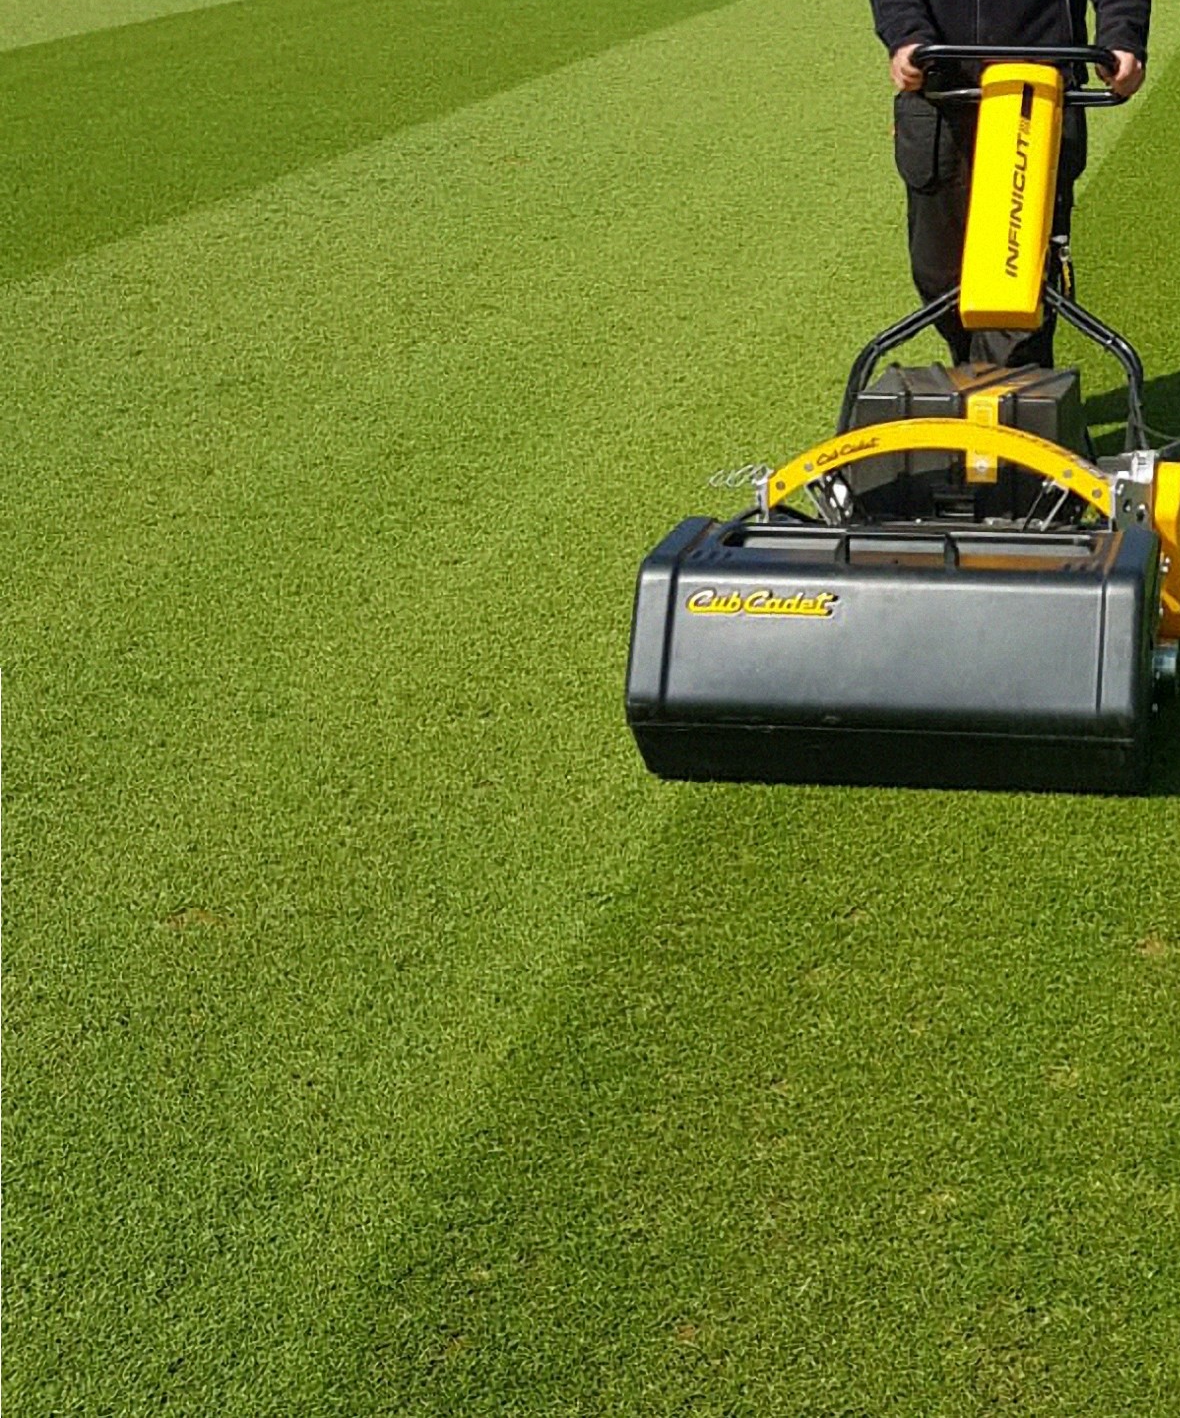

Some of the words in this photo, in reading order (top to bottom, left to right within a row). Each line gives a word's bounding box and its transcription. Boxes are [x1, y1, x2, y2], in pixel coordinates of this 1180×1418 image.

[1005, 132, 1031, 278] INFINICUT
[686, 588, 742, 614] Cub
[743, 588, 836, 616] Cadet
